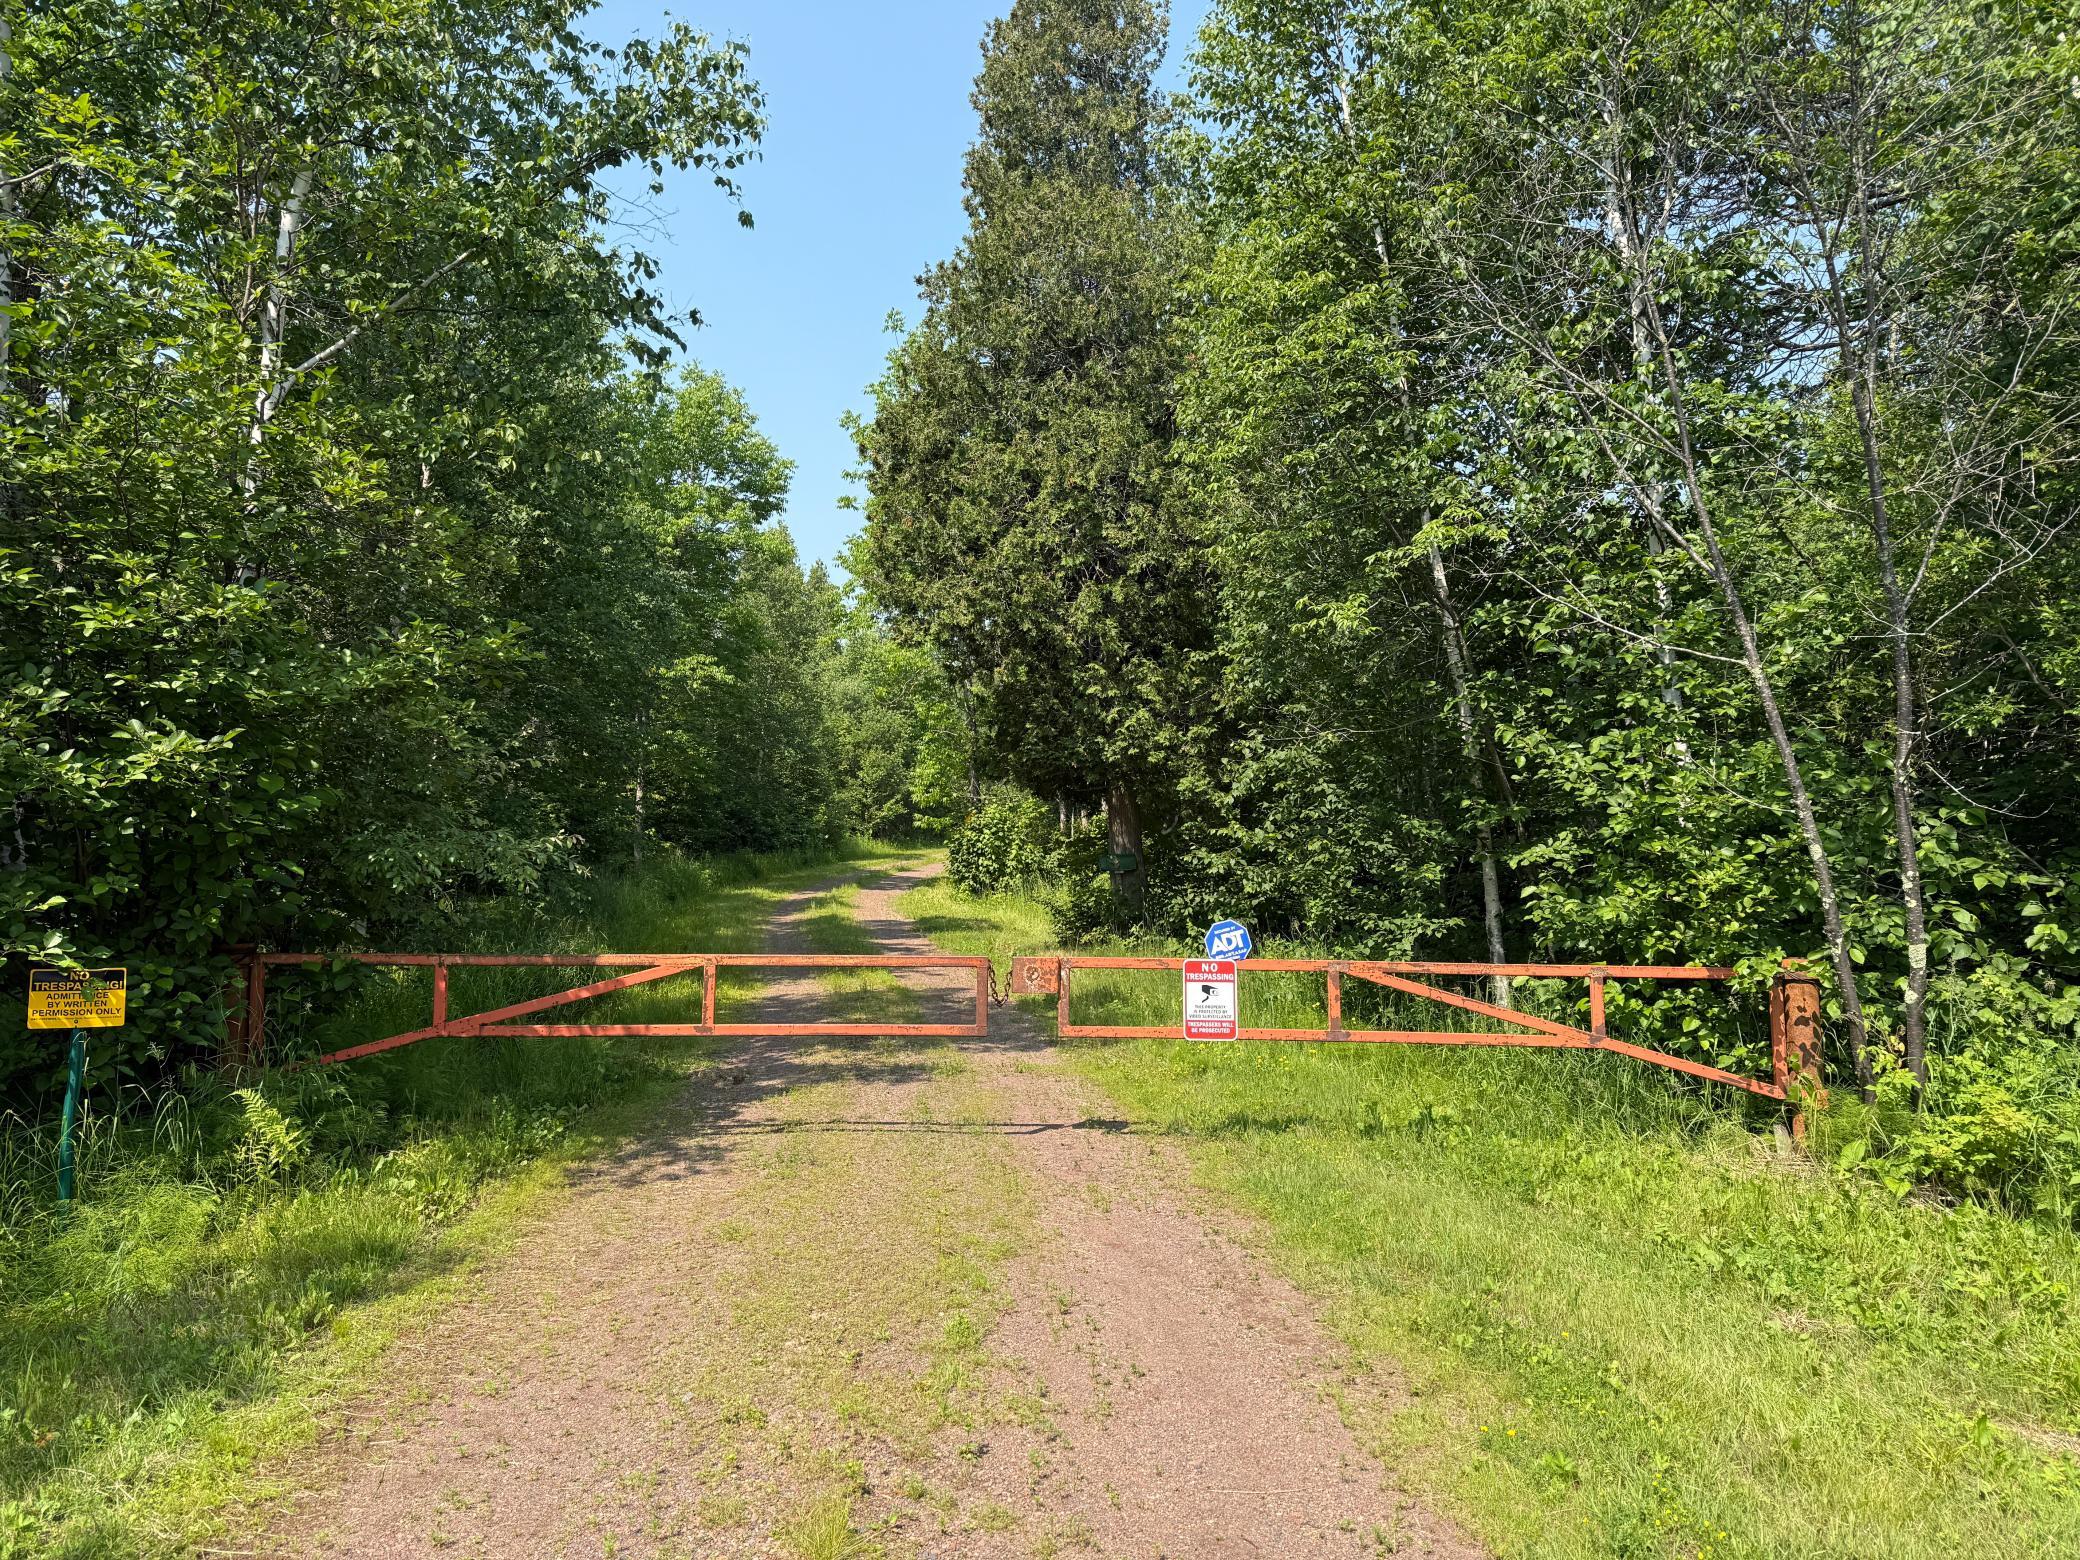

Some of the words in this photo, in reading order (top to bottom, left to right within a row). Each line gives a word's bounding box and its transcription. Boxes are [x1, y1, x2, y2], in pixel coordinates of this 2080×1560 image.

[1211, 929, 1245, 955] ADT
[1202, 963, 1218, 972] NO
[70, 971, 90, 980] NO
[34, 981, 123, 991] TRESPAG!
[46, 992, 109, 1000] ADMITTCE
[64, 1000, 107, 1008] WRITTEN
[32, 1009, 93, 1017] PERMISSION
[95, 1007, 122, 1015] ONLY
